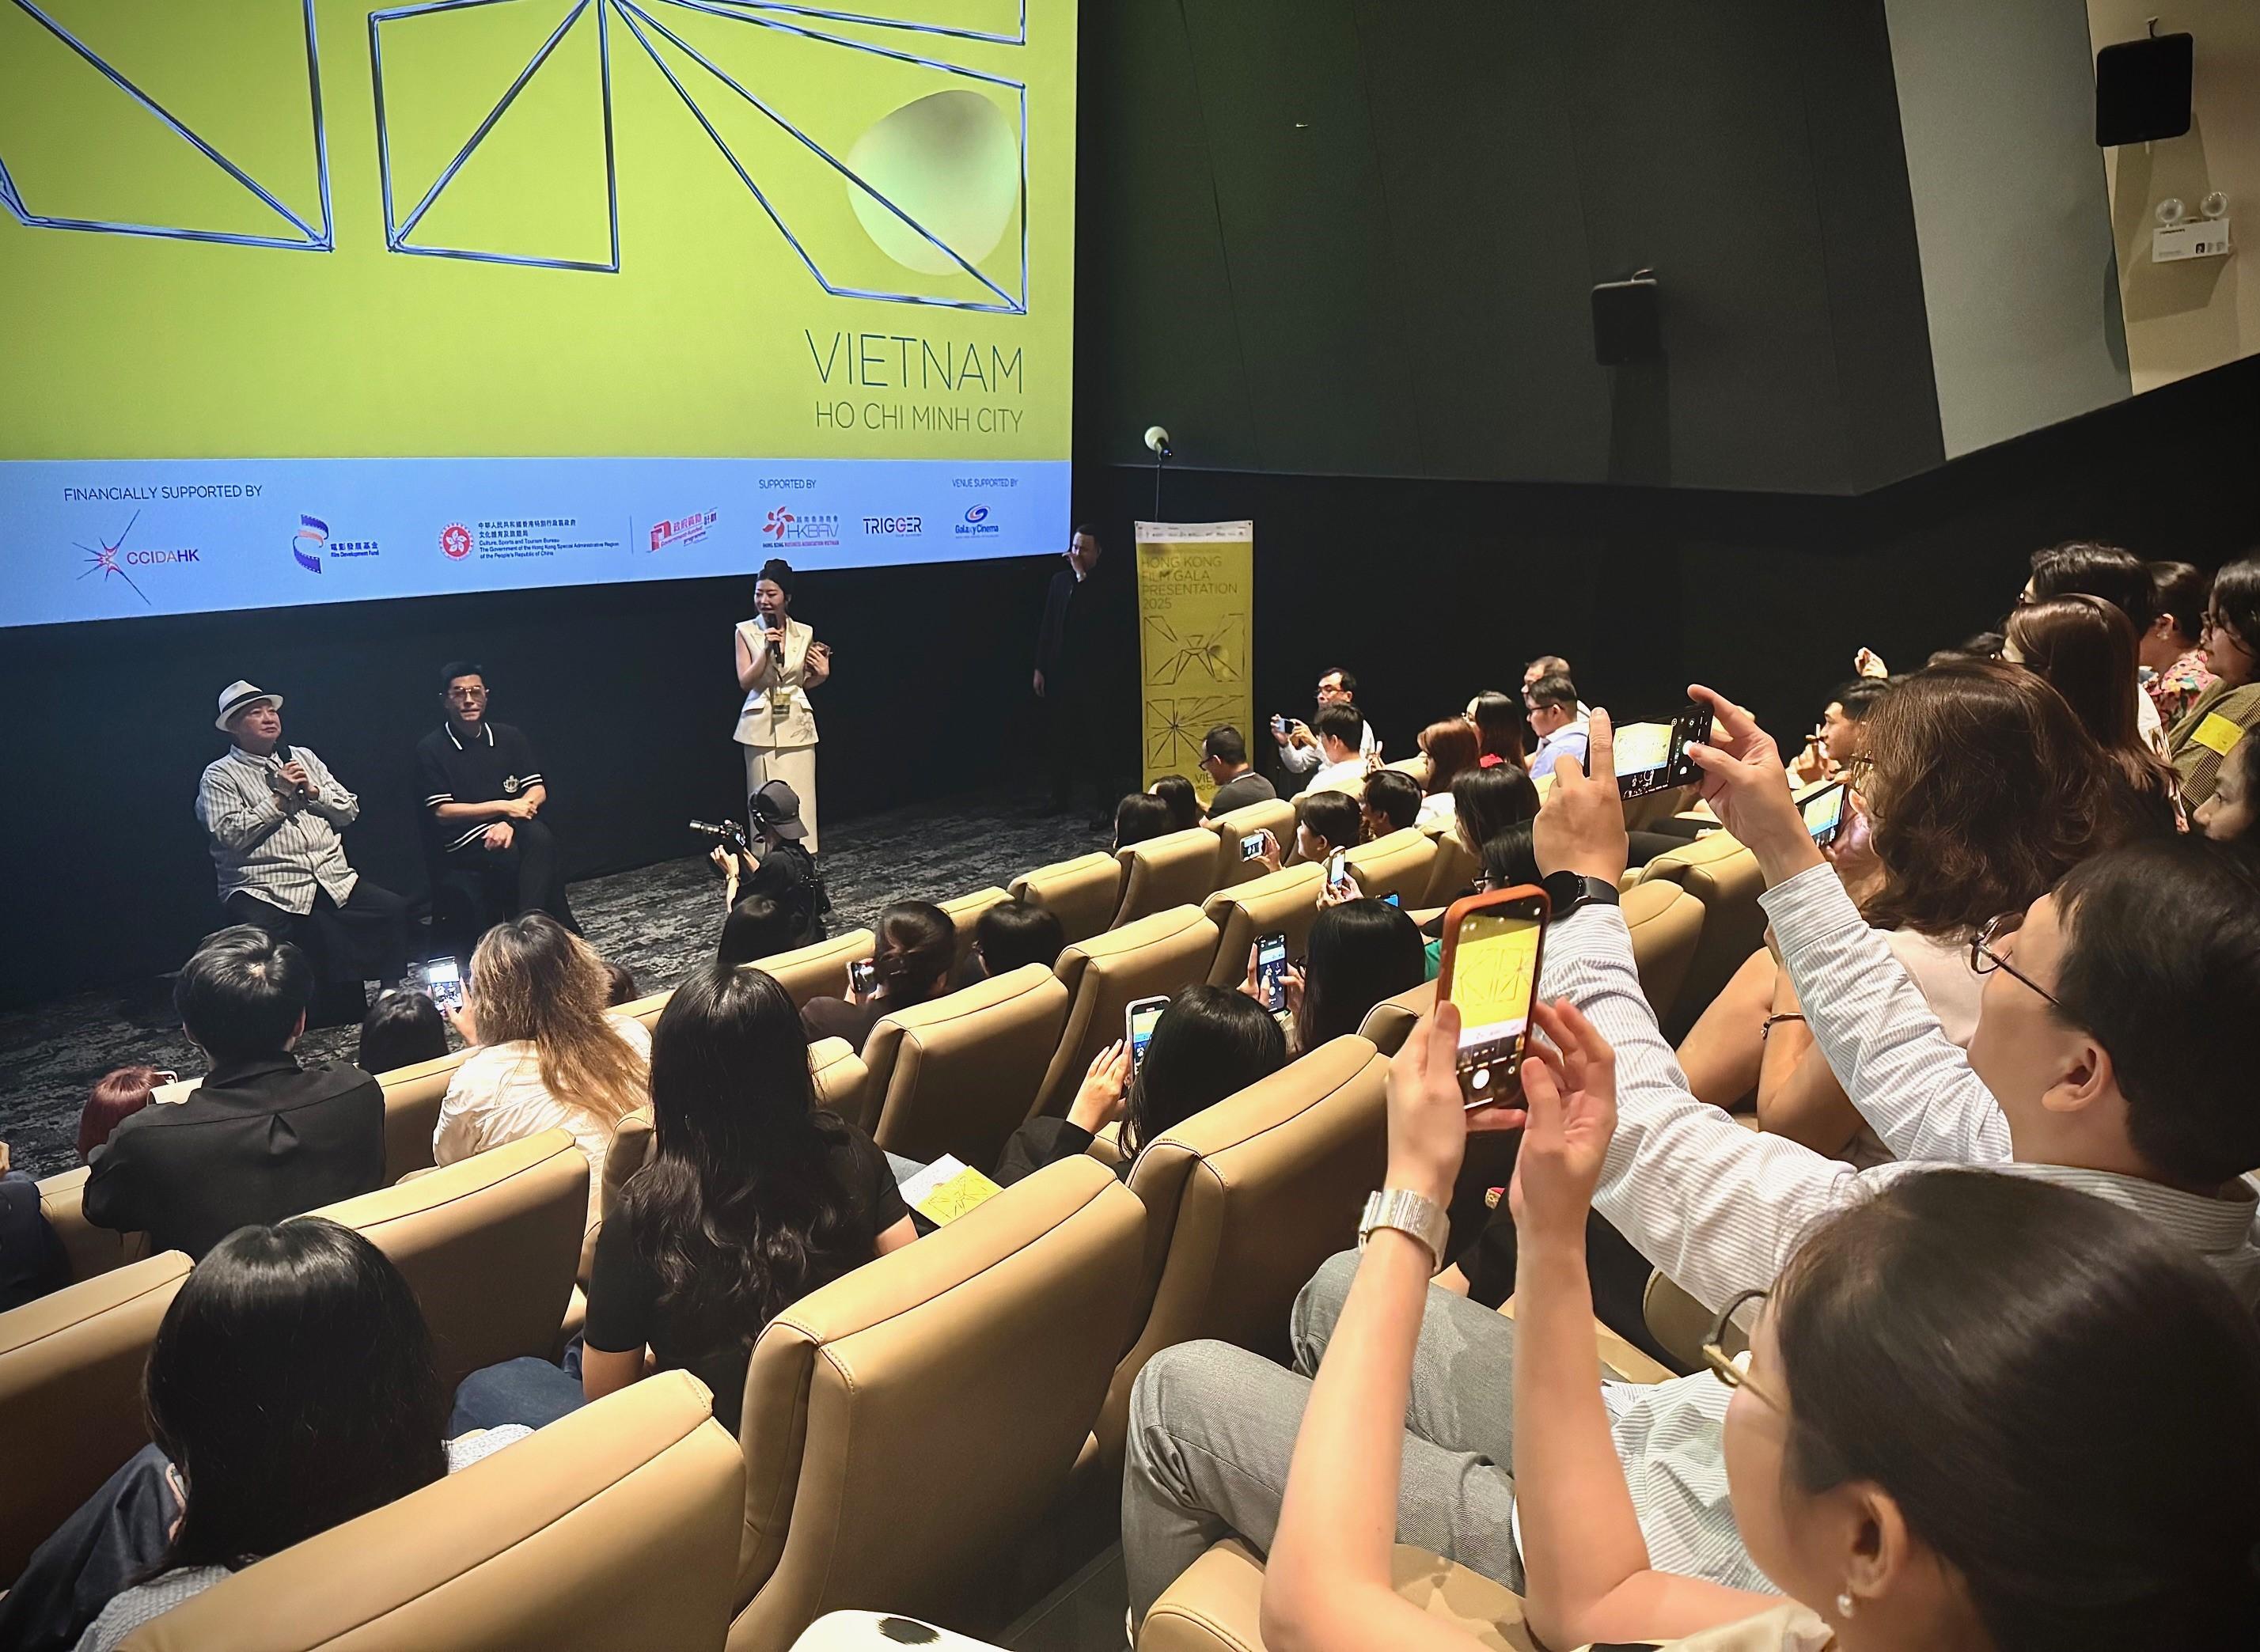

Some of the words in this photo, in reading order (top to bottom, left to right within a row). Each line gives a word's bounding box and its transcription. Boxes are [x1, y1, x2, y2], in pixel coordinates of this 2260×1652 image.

[805, 329, 1022, 394] VIETNAM
[817, 401, 855, 428] HO
[864, 403, 903, 430] CHI
[912, 405, 969, 431] MINH
[977, 407, 1023, 433] CITY
[759, 479, 805, 489] SUPPORTED
[806, 479, 817, 489] BY
[952, 478, 973, 487] VENUE
[974, 478, 1010, 487] SUPPORTED
[1011, 478, 1018, 487] BY
[64, 487, 157, 501] FINANCIALLY
[161, 485, 243, 499] SUPPORTED
[245, 485, 263, 497] BY
[863, 517, 922, 534] TRIGGER
[955, 525, 976, 535] Galaxy
[977, 524, 999, 533] Cinema
[127, 549, 200, 565] CCIDAHK
[1142, 556, 1180, 567] HONG
[1184, 555, 1222, 567] KONG
[1142, 570, 1171, 582] FILM
[1174, 570, 1210, 582] GALA
[1142, 582, 1238, 595] PRESENTATION
[1143, 597, 1172, 610] 2025
